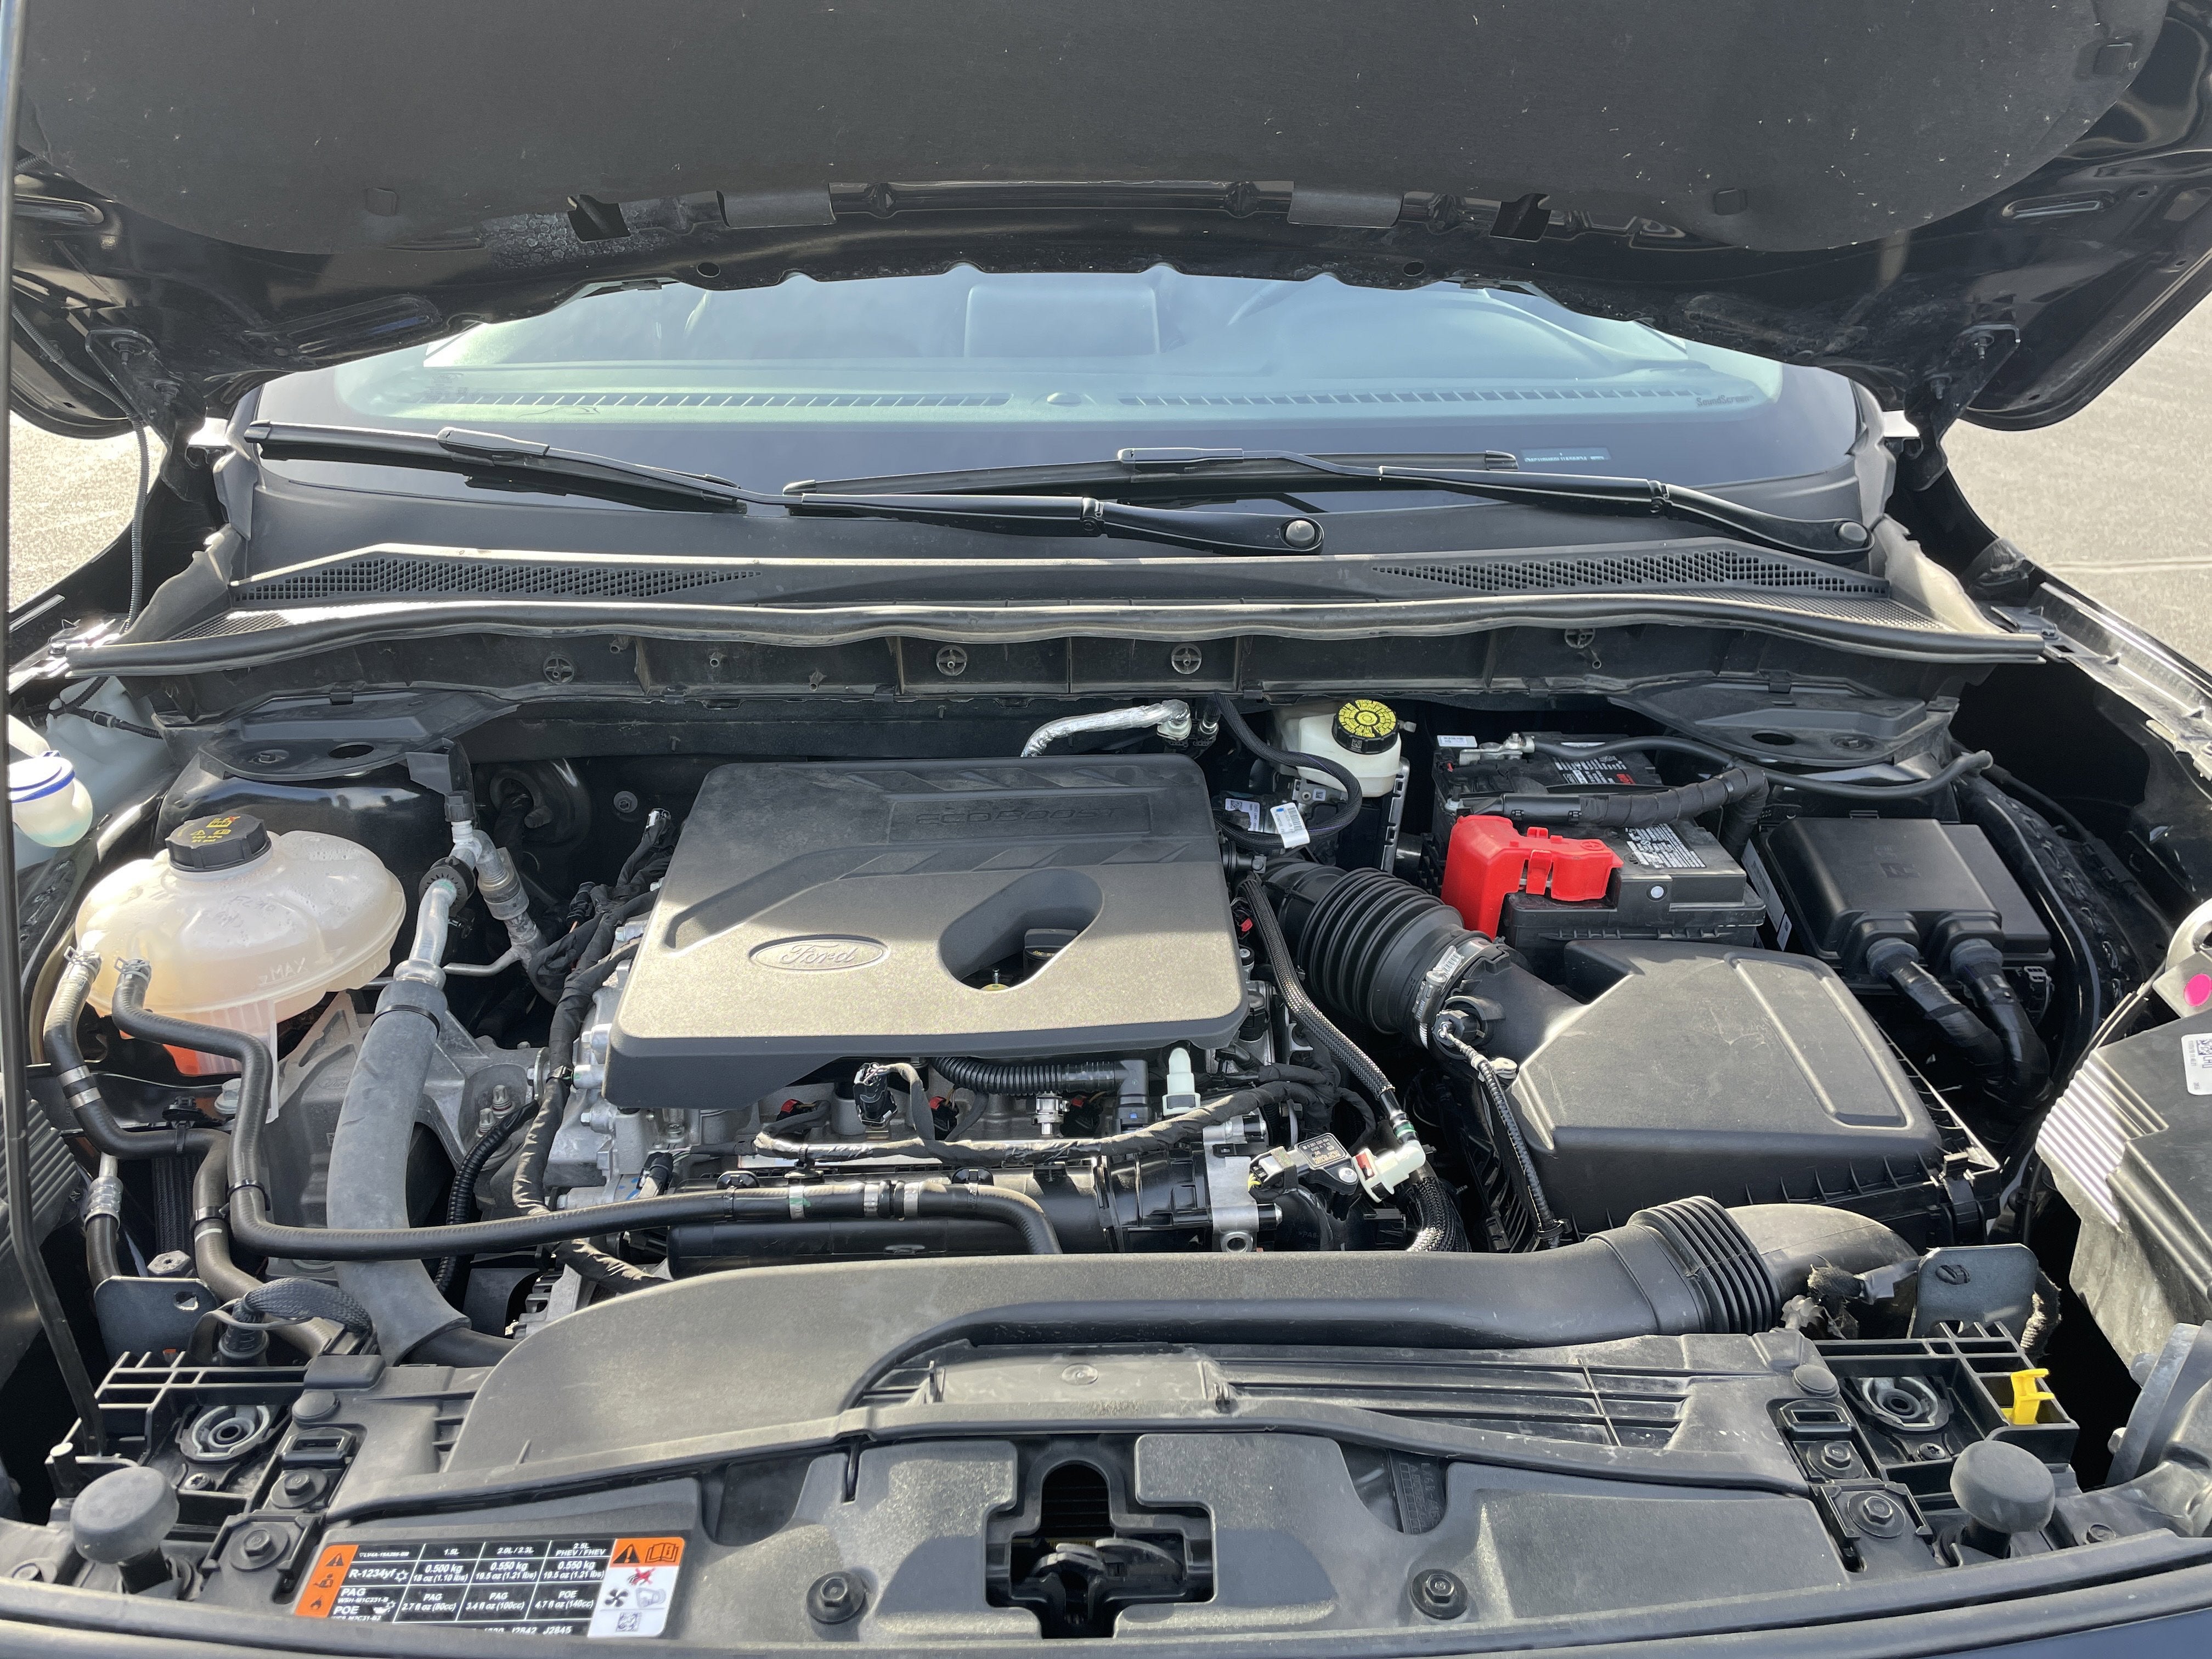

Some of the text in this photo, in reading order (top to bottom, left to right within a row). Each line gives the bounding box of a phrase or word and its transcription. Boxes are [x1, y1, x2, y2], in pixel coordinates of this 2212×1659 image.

[1696, 394, 1754, 407] SoundScreen
[781, 944, 858, 964] Ford
[269, 957, 308, 980] MAX
[425, 1564, 464, 1574] 0.500 kg
[490, 1561, 529, 1572] 0.550 kg
[557, 1561, 596, 1570] 0.550 kg
[348, 1568, 397, 1580] R-1234yf
[433, 1574, 453, 1583] (1.10
[454, 1573, 469, 1583] lbs)
[503, 1571, 521, 1581] (1.21
[522, 1571, 537, 1580] lbs)
[570, 1571, 588, 1581] (1.21
[589, 1570, 605, 1579] lbs)
[341, 1588, 366, 1596] PAG
[489, 1592, 509, 1600] PAG
[558, 1590, 578, 1599] POE
[402, 1602, 414, 1611] 2.7
[415, 1602, 421, 1611] fl
[466, 1601, 478, 1610] 3.4
[479, 1601, 486, 1610] fl
[496, 1601, 525, 1611] (100cc)
[535, 1600, 548, 1609] 4.7
[566, 1600, 594, 1610] (140cc)
[333, 1606, 360, 1615] POE
